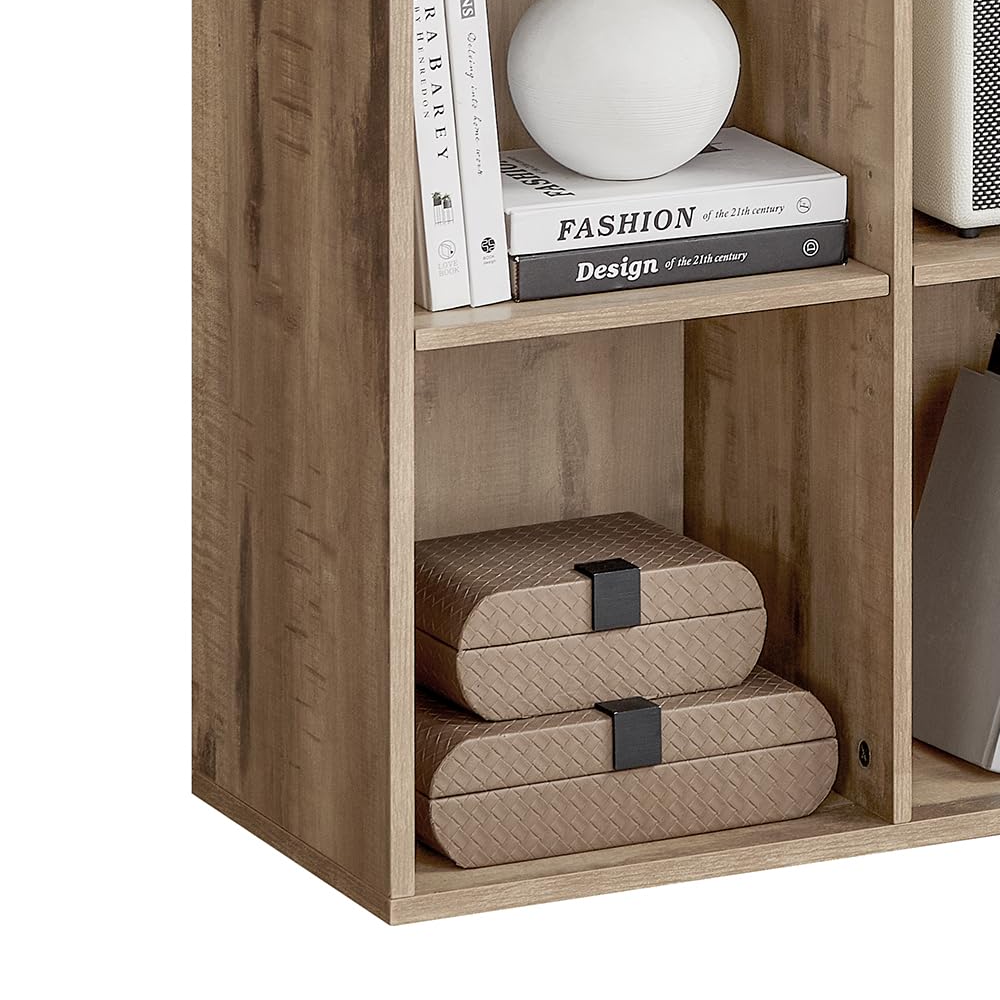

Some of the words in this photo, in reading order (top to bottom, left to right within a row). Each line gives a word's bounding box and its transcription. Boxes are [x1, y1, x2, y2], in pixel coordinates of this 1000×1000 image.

[416, 31, 430, 118] HENREDON
[429, 56, 449, 159] BAREY
[557, 206, 697, 241] FASHION
[702, 209, 714, 221] of
[715, 208, 729, 219] the
[730, 206, 750, 217] 21th
[752, 203, 785, 215] century
[576, 256, 658, 281] Design
[664, 257, 676, 271] of
[677, 255, 691, 267] the
[692, 253, 712, 266] 21th
[714, 251, 748, 264] century
